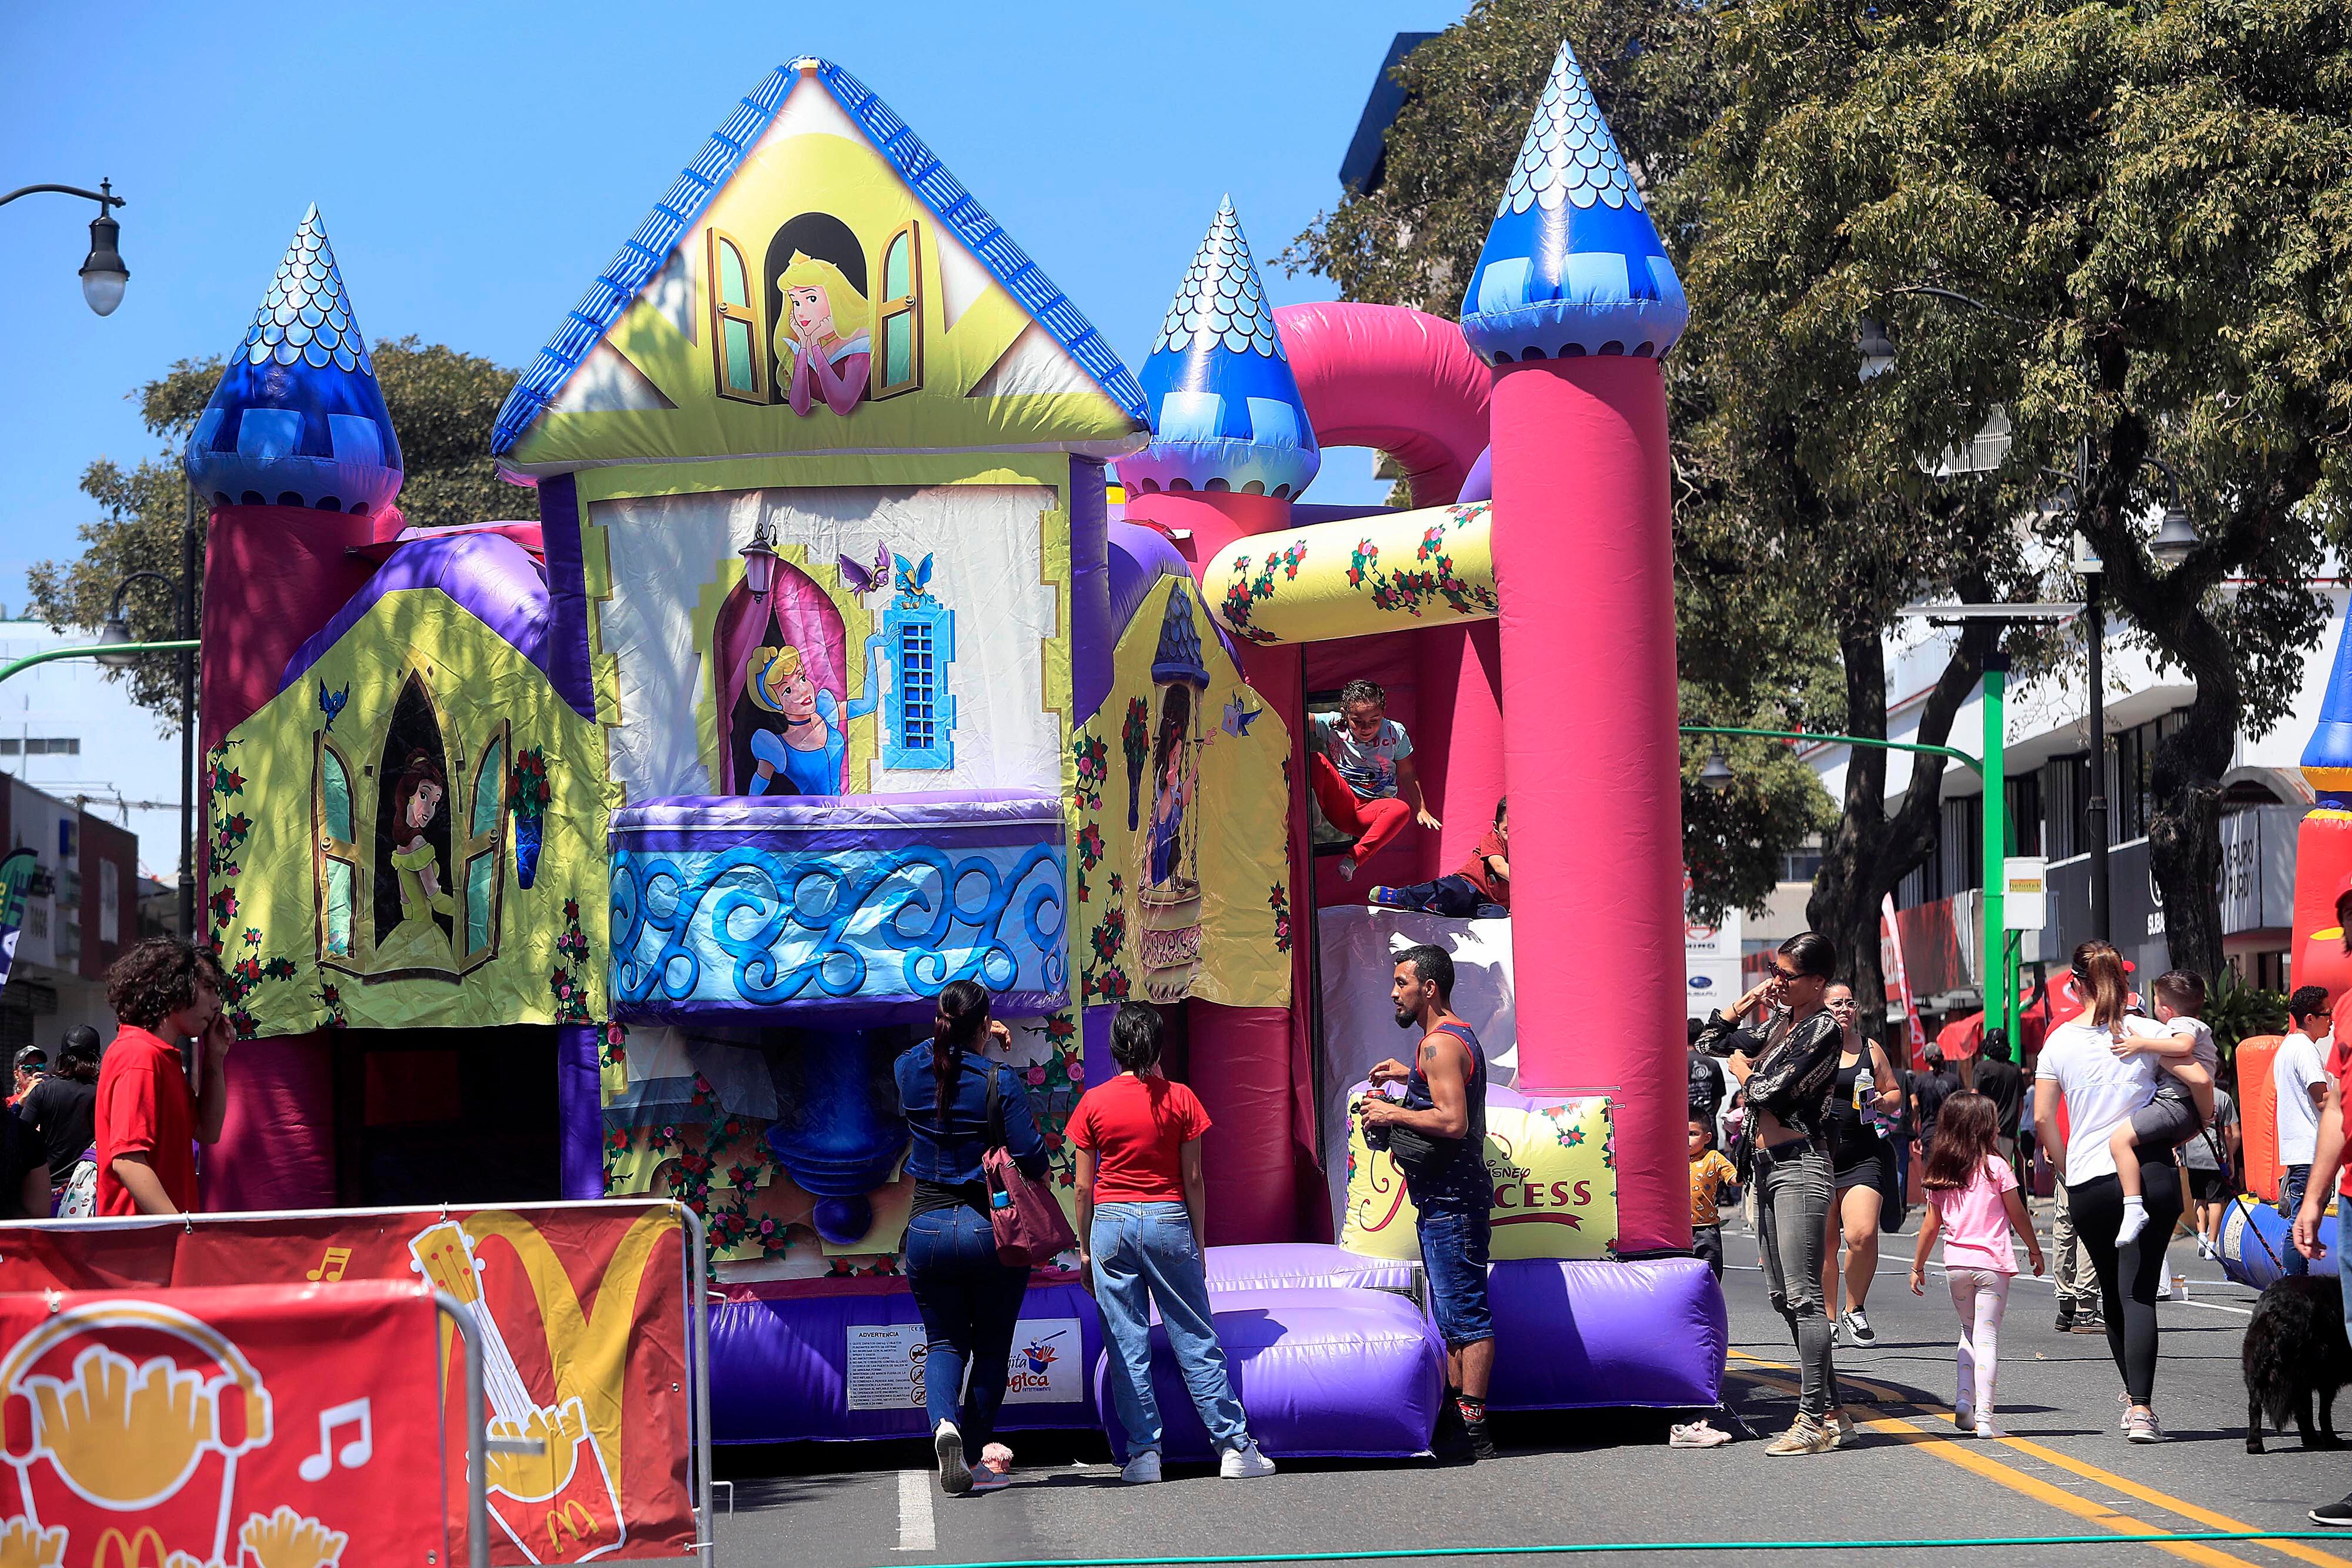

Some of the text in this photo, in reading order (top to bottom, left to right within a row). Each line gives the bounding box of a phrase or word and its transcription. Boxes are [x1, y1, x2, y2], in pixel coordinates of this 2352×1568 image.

[2227, 839, 2254, 871] GRUPO
[2229, 871, 2254, 901] PURDY
[2147, 912, 2166, 936] SUBA
[1494, 1181, 1592, 1209] CESS
[1008, 1353, 1027, 1369] jita
[1007, 1371, 1050, 1393] gica
